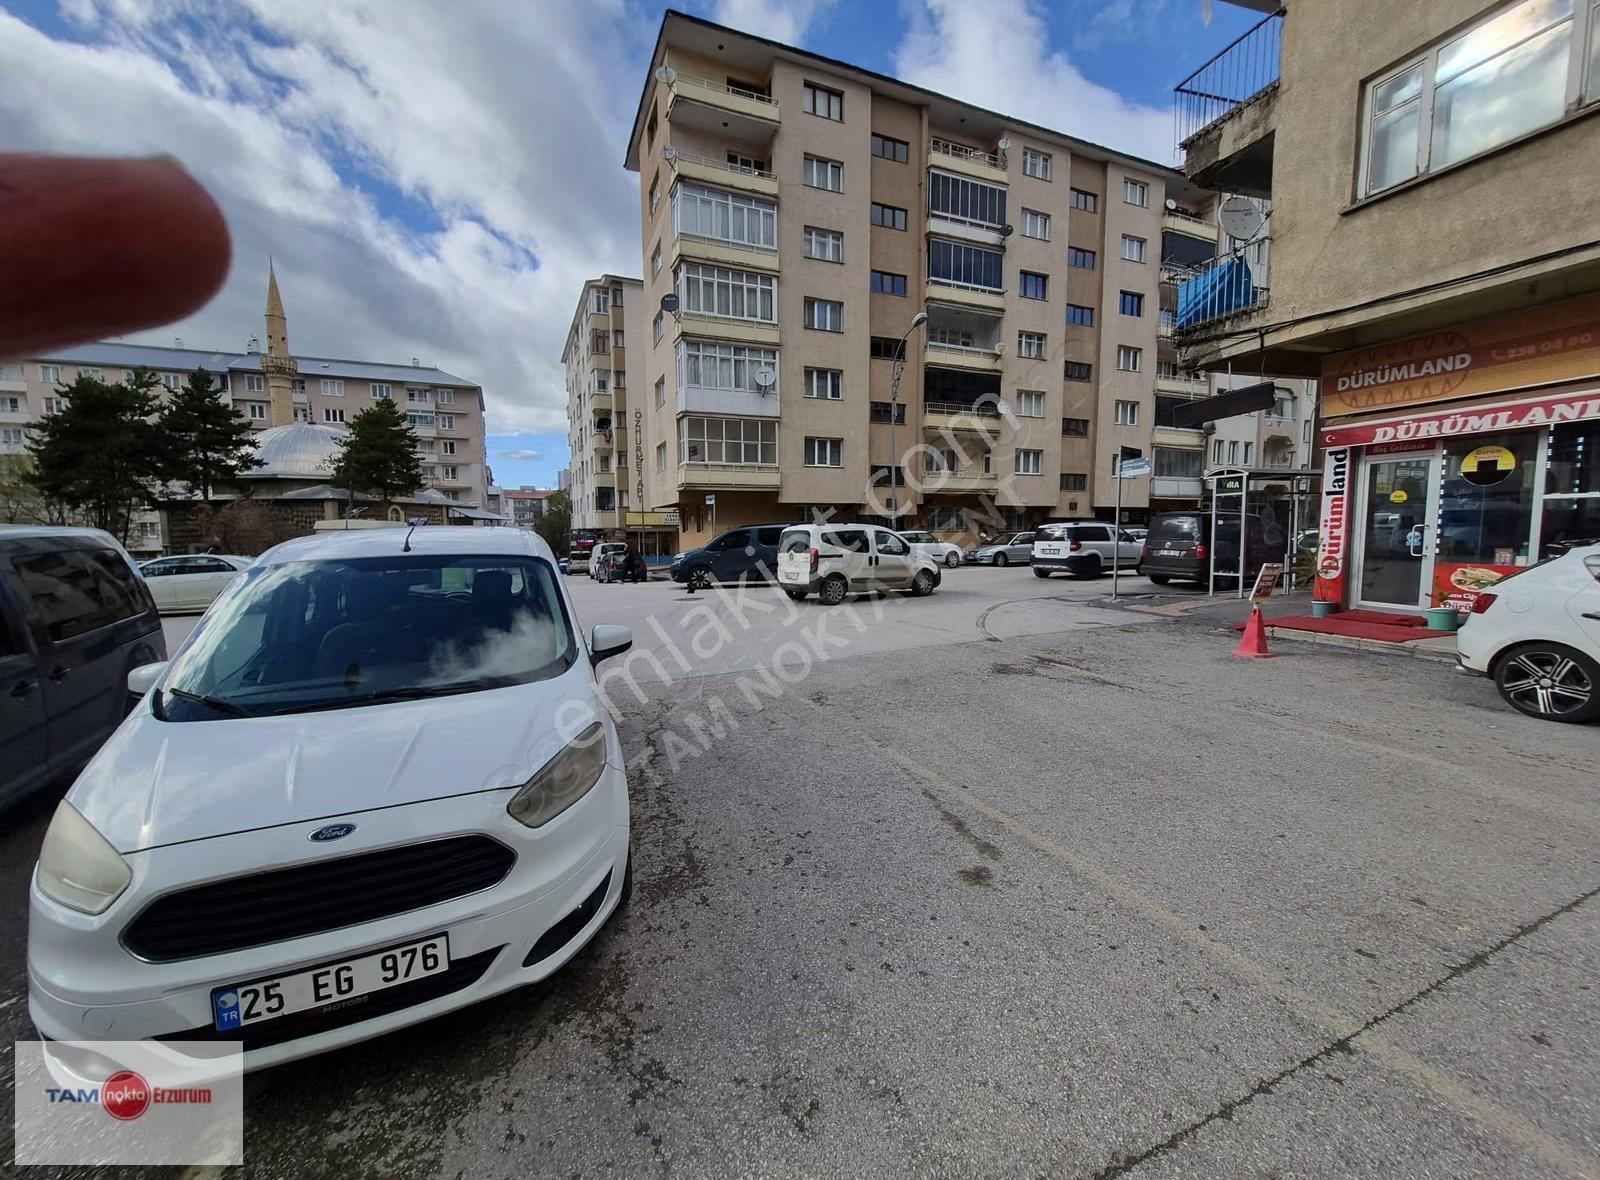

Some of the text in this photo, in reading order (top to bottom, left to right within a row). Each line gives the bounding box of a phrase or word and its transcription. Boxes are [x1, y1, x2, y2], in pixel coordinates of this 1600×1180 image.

[1337, 353, 1472, 391] DÜRÜMLAND
[1320, 448, 1348, 576] Dürümland
[318, 826, 348, 840] Ford
[222, 943, 439, 1023] TR 25 EG 976
